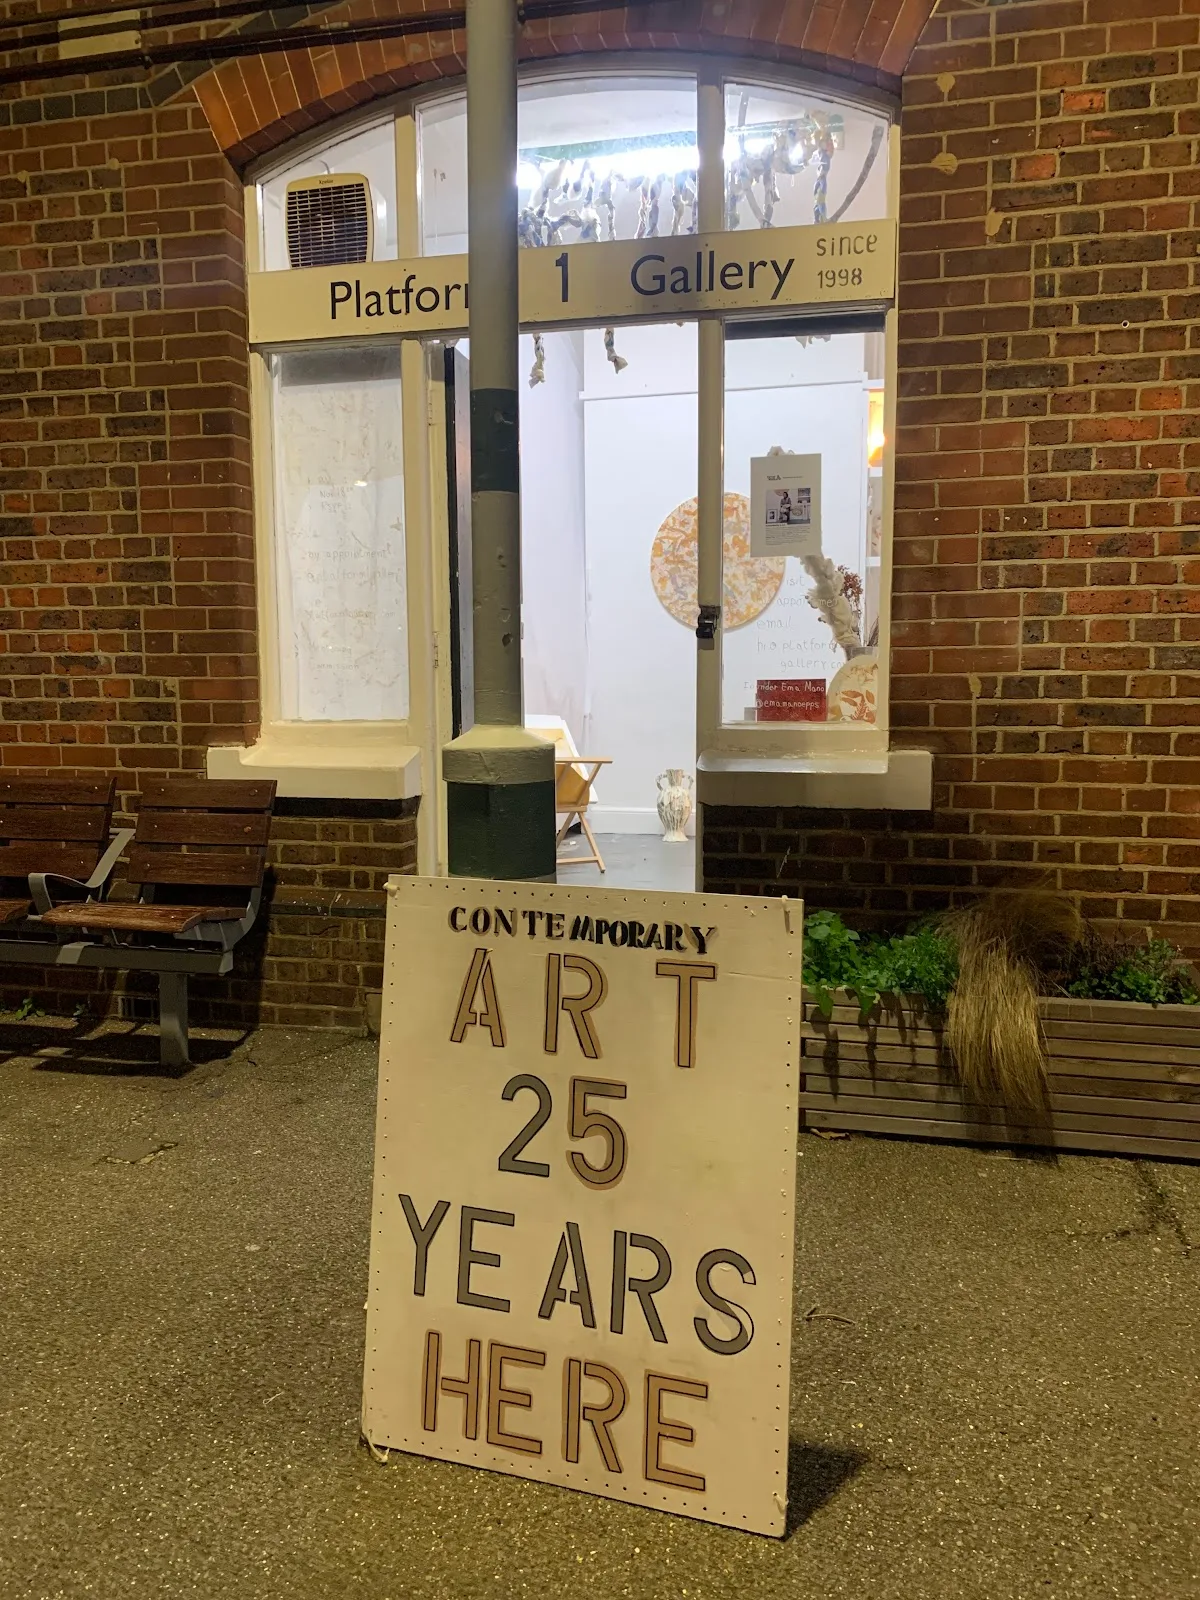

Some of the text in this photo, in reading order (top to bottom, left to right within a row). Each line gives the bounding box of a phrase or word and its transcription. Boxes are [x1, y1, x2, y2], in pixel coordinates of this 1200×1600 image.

[816, 234, 878, 257] since
[817, 267, 863, 289] 1998
[330, 250, 795, 320] Platfor 1 Gallery
[781, 682, 801, 692] Ema
[448, 905, 718, 955] CONTEMPORARY
[449, 947, 718, 1069] ART
[498, 1073, 628, 1188] 25
[398, 1193, 757, 1356] YEARS
[422, 1330, 710, 1492] HERE
